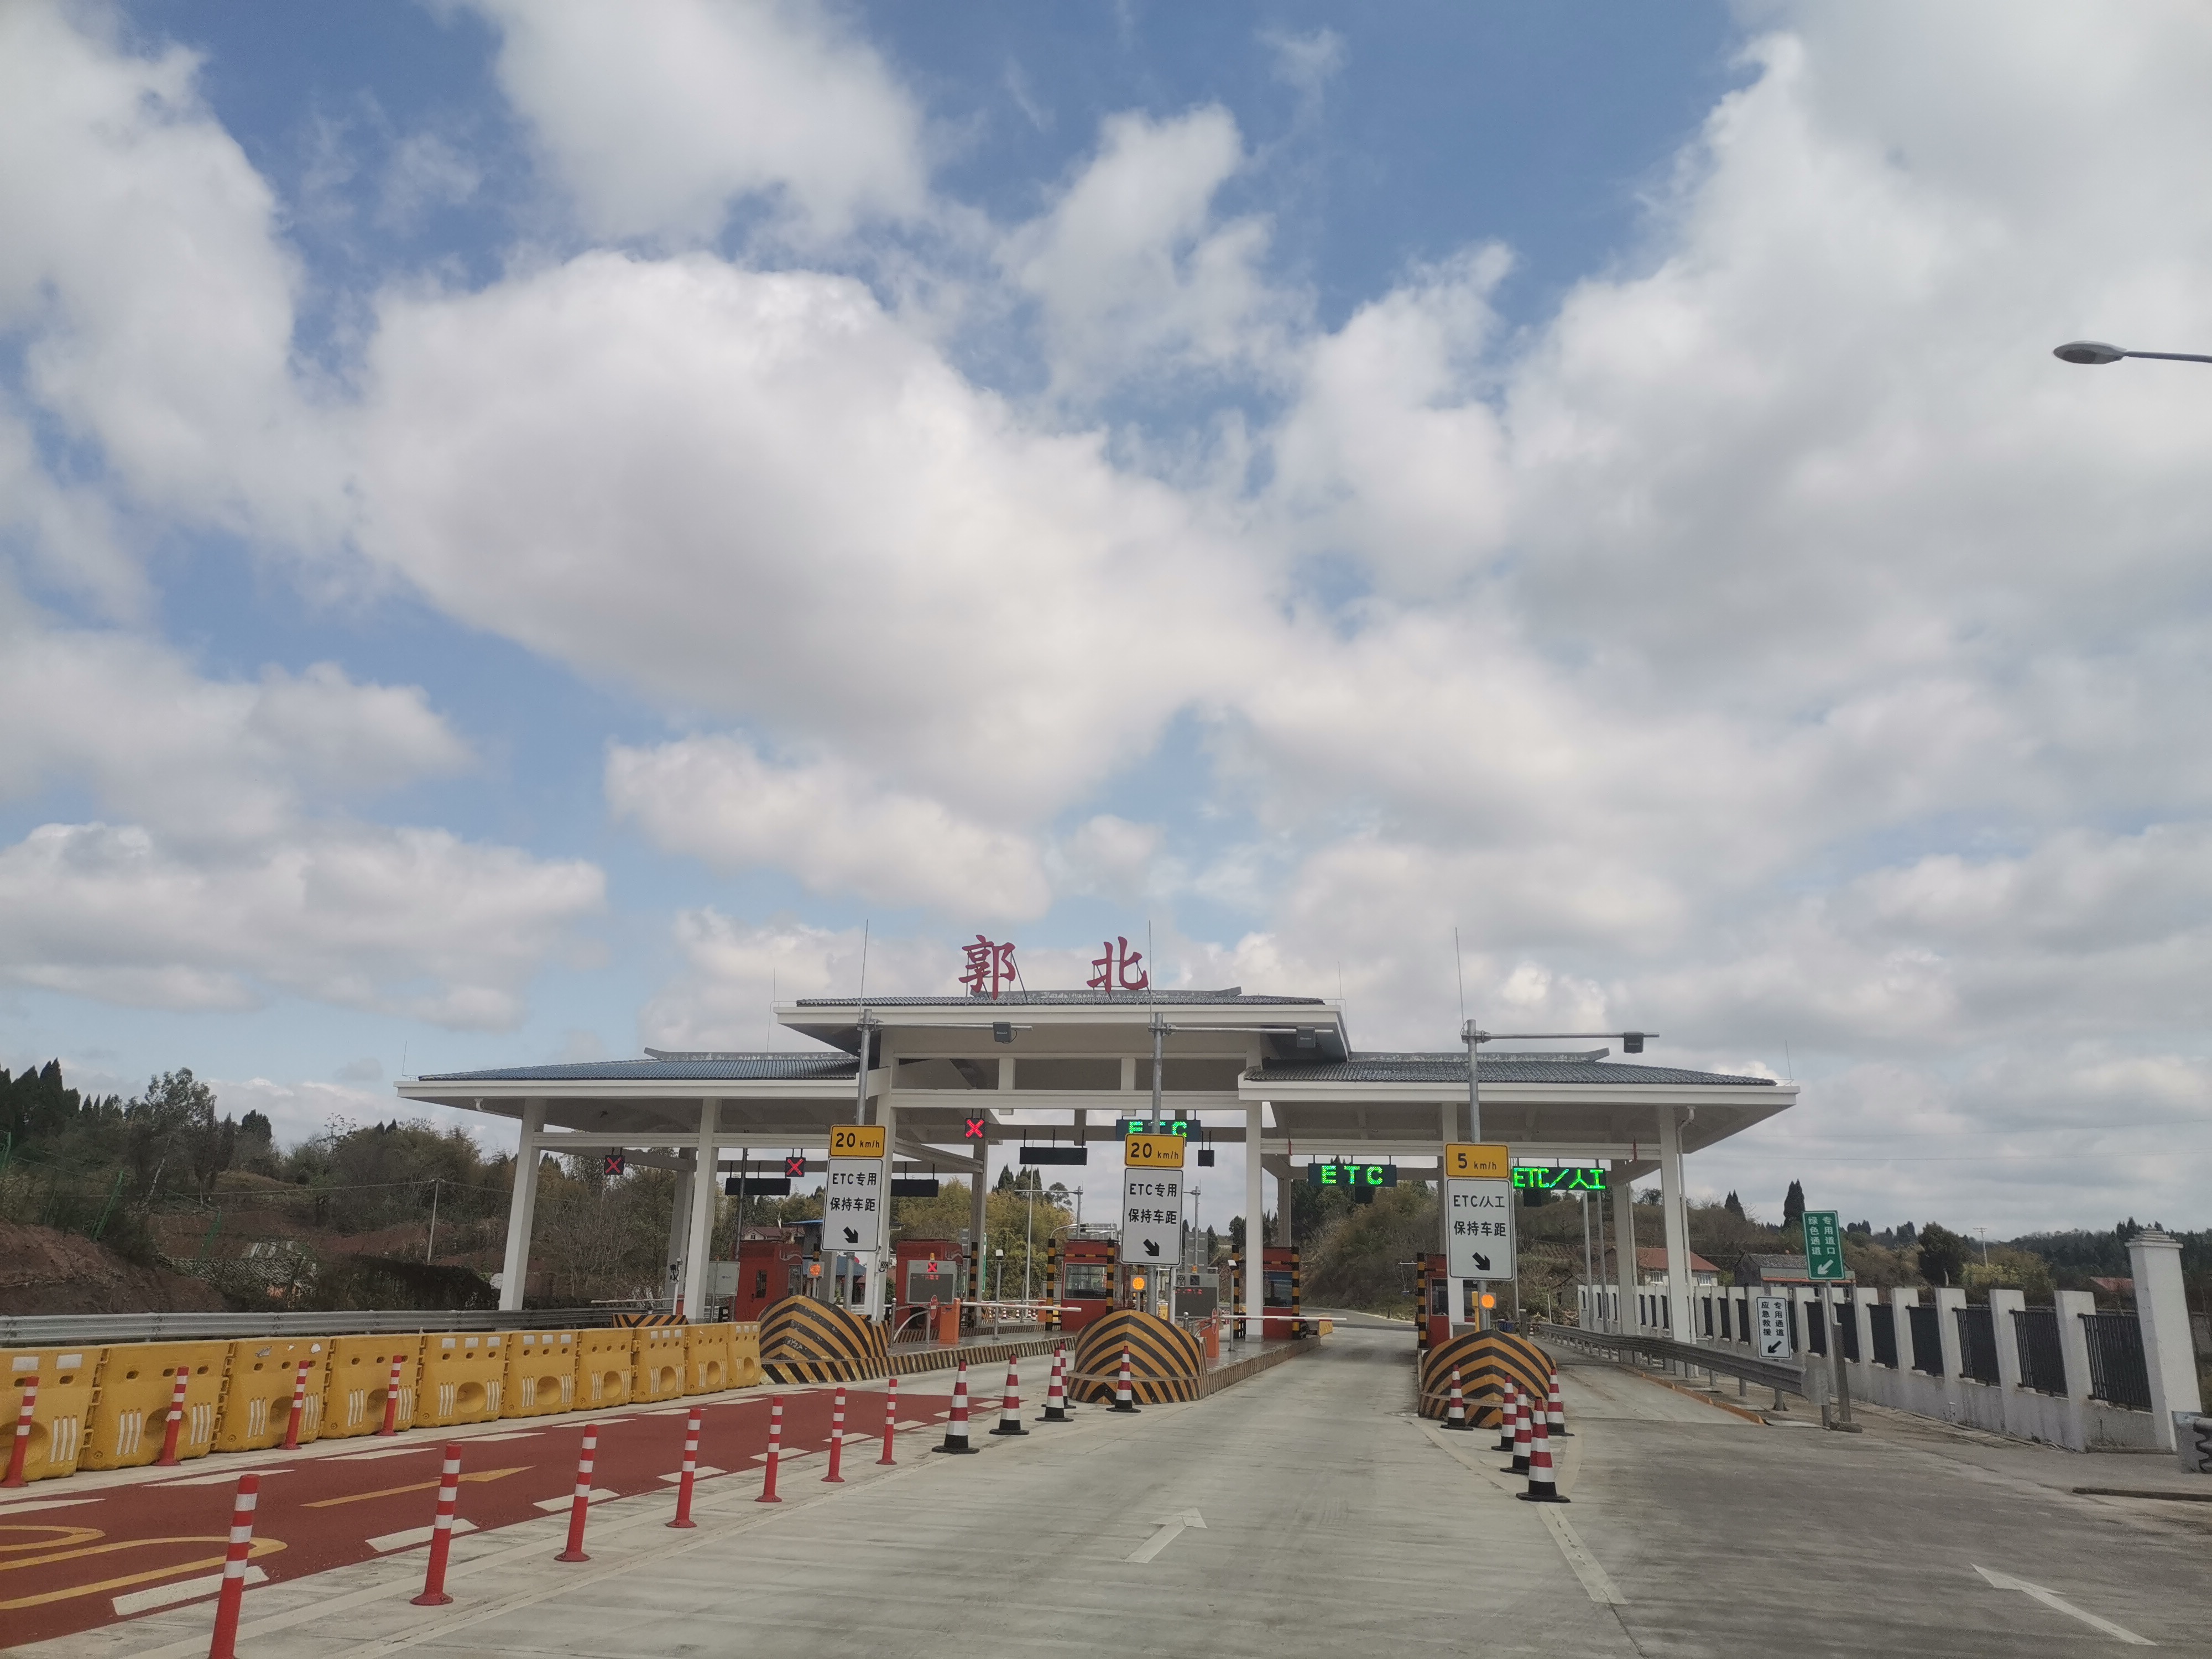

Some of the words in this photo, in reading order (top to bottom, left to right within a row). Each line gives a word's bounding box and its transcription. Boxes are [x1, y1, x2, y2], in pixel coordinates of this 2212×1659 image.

[958, 935, 1149, 1000] 郭北
[835, 1132, 855, 1147] 20
[859, 1140, 880, 1149] km/h
[1130, 1142, 1152, 1159] 20
[1157, 1150, 1179, 1160] km/h
[1458, 1152, 1468, 1169] 5
[1474, 1161, 1497, 1171] km/h
[832, 1172, 877, 1186] ETC专用
[1321, 1165, 1383, 1185] ETC
[1513, 1167, 1606, 1190] ETC/人工
[1129, 1182, 1177, 1197] ETC专用
[830, 1197, 875, 1212] 保持车距
[1453, 1194, 1505, 1208] ETC/人工
[1128, 1208, 1177, 1224] 保持车距
[1453, 1220, 1506, 1237] 保持车距
[1807, 1215, 1822, 1256] 绿色通道
[1822, 1215, 1836, 1255] 专用道口
[1761, 1301, 1772, 1337] 应急救援
[1773, 1301, 1785, 1337] 专用通道
